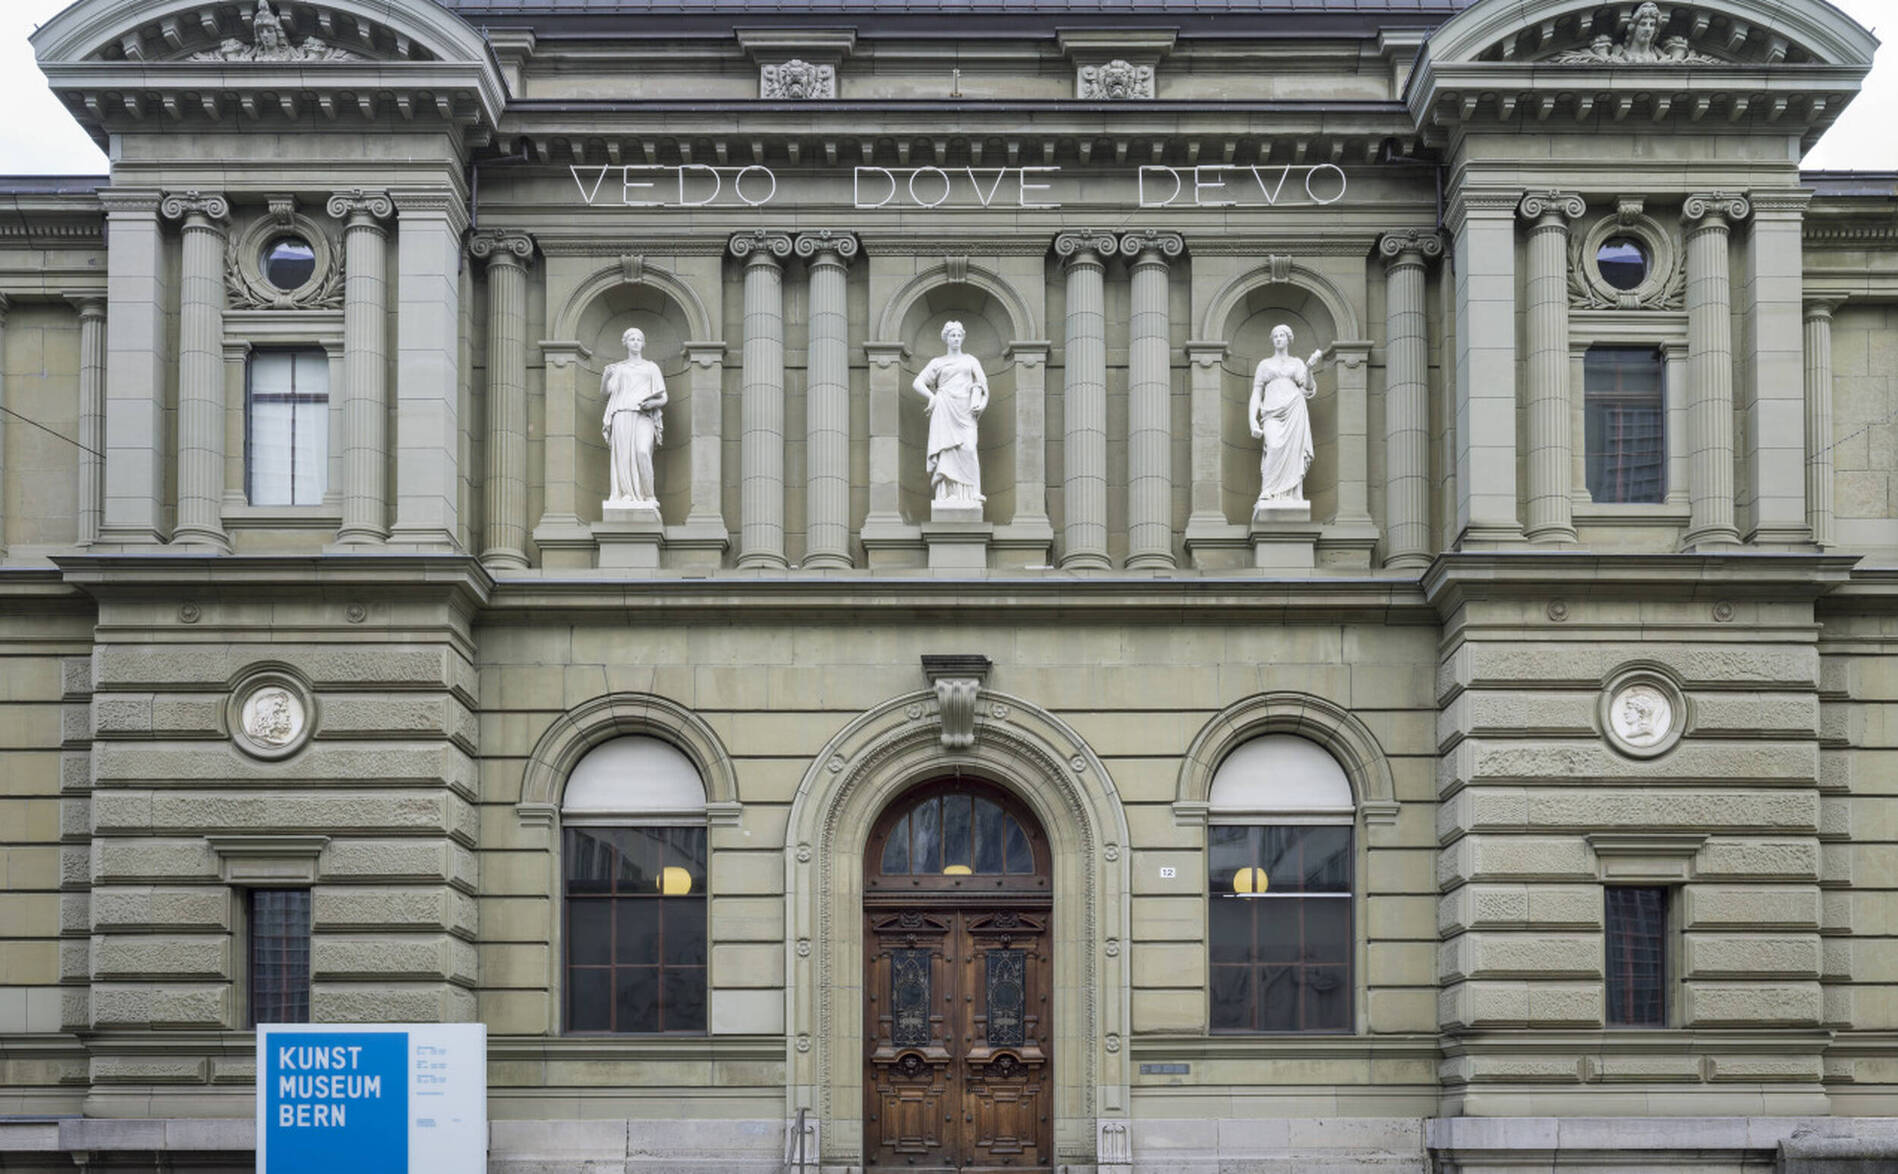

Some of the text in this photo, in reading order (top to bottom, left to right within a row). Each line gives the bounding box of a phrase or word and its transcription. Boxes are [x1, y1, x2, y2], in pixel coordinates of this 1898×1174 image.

[569, 163, 1347, 209] VEDO DOVE DEVO
[278, 1046, 363, 1070] KUNST
[278, 1075, 382, 1099] MUSEUM
[278, 1103, 347, 1127] BERN
